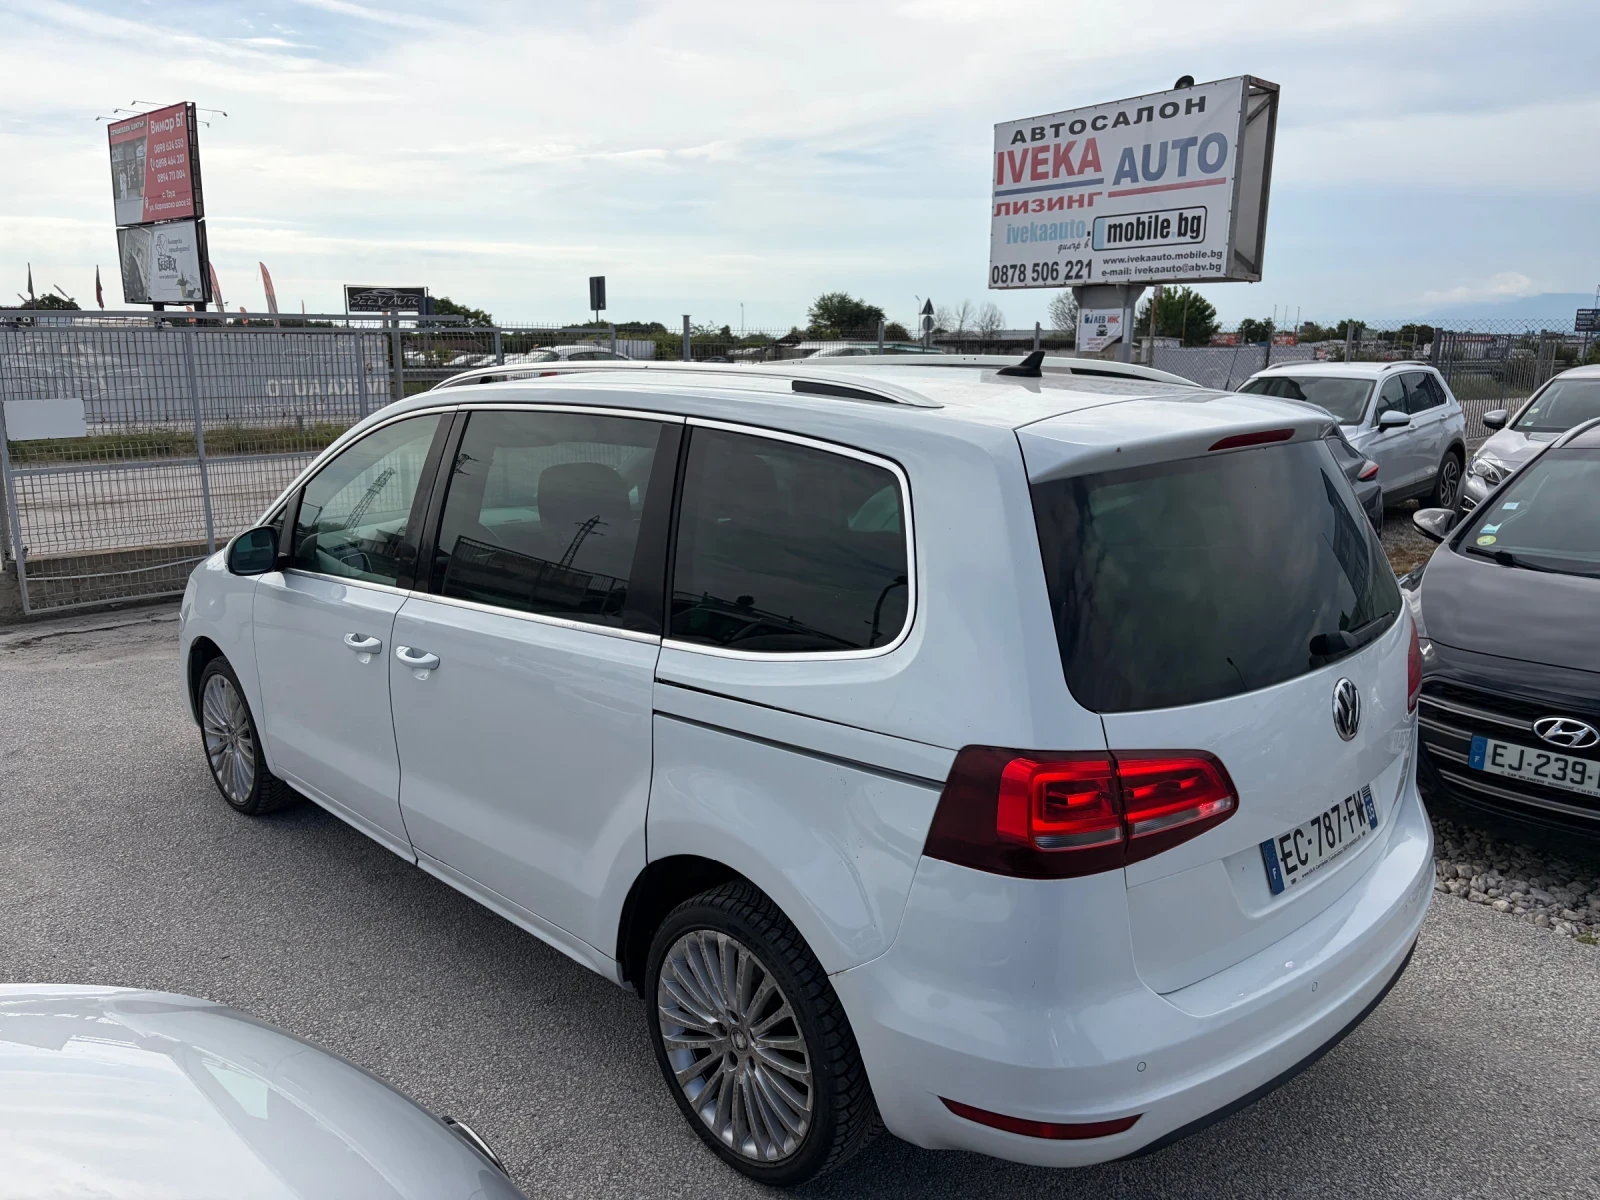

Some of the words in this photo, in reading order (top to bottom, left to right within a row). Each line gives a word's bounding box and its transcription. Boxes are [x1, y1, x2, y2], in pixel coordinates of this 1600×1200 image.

[150, 117, 175, 134] Вимар
[1010, 96, 1206, 145] АВТОСАЛОН
[996, 137, 1102, 186] IVEKA
[1112, 132, 1228, 186] AUTO
[994, 192, 1102, 217] ЛИЗИНГ
[1106, 212, 1202, 244] mobile.bg
[1101, 267, 1132, 277] e-mail:
[1134, 262, 1222, 276] ivekaauto@abv.bg
[1102, 250, 1223, 265] www.ivekaauto.mobile.bg
[992, 263, 1027, 284] 0878
[1031, 261, 1059, 282] 506
[1064, 258, 1092, 280] 221
[1107, 315, 1120, 324] ИНС
[1474, 755, 1481, 763] F
[1491, 743, 1600, 789] EJ-239-
[1279, 790, 1366, 876] EC-787-FW
[1272, 867, 1277, 880] F
